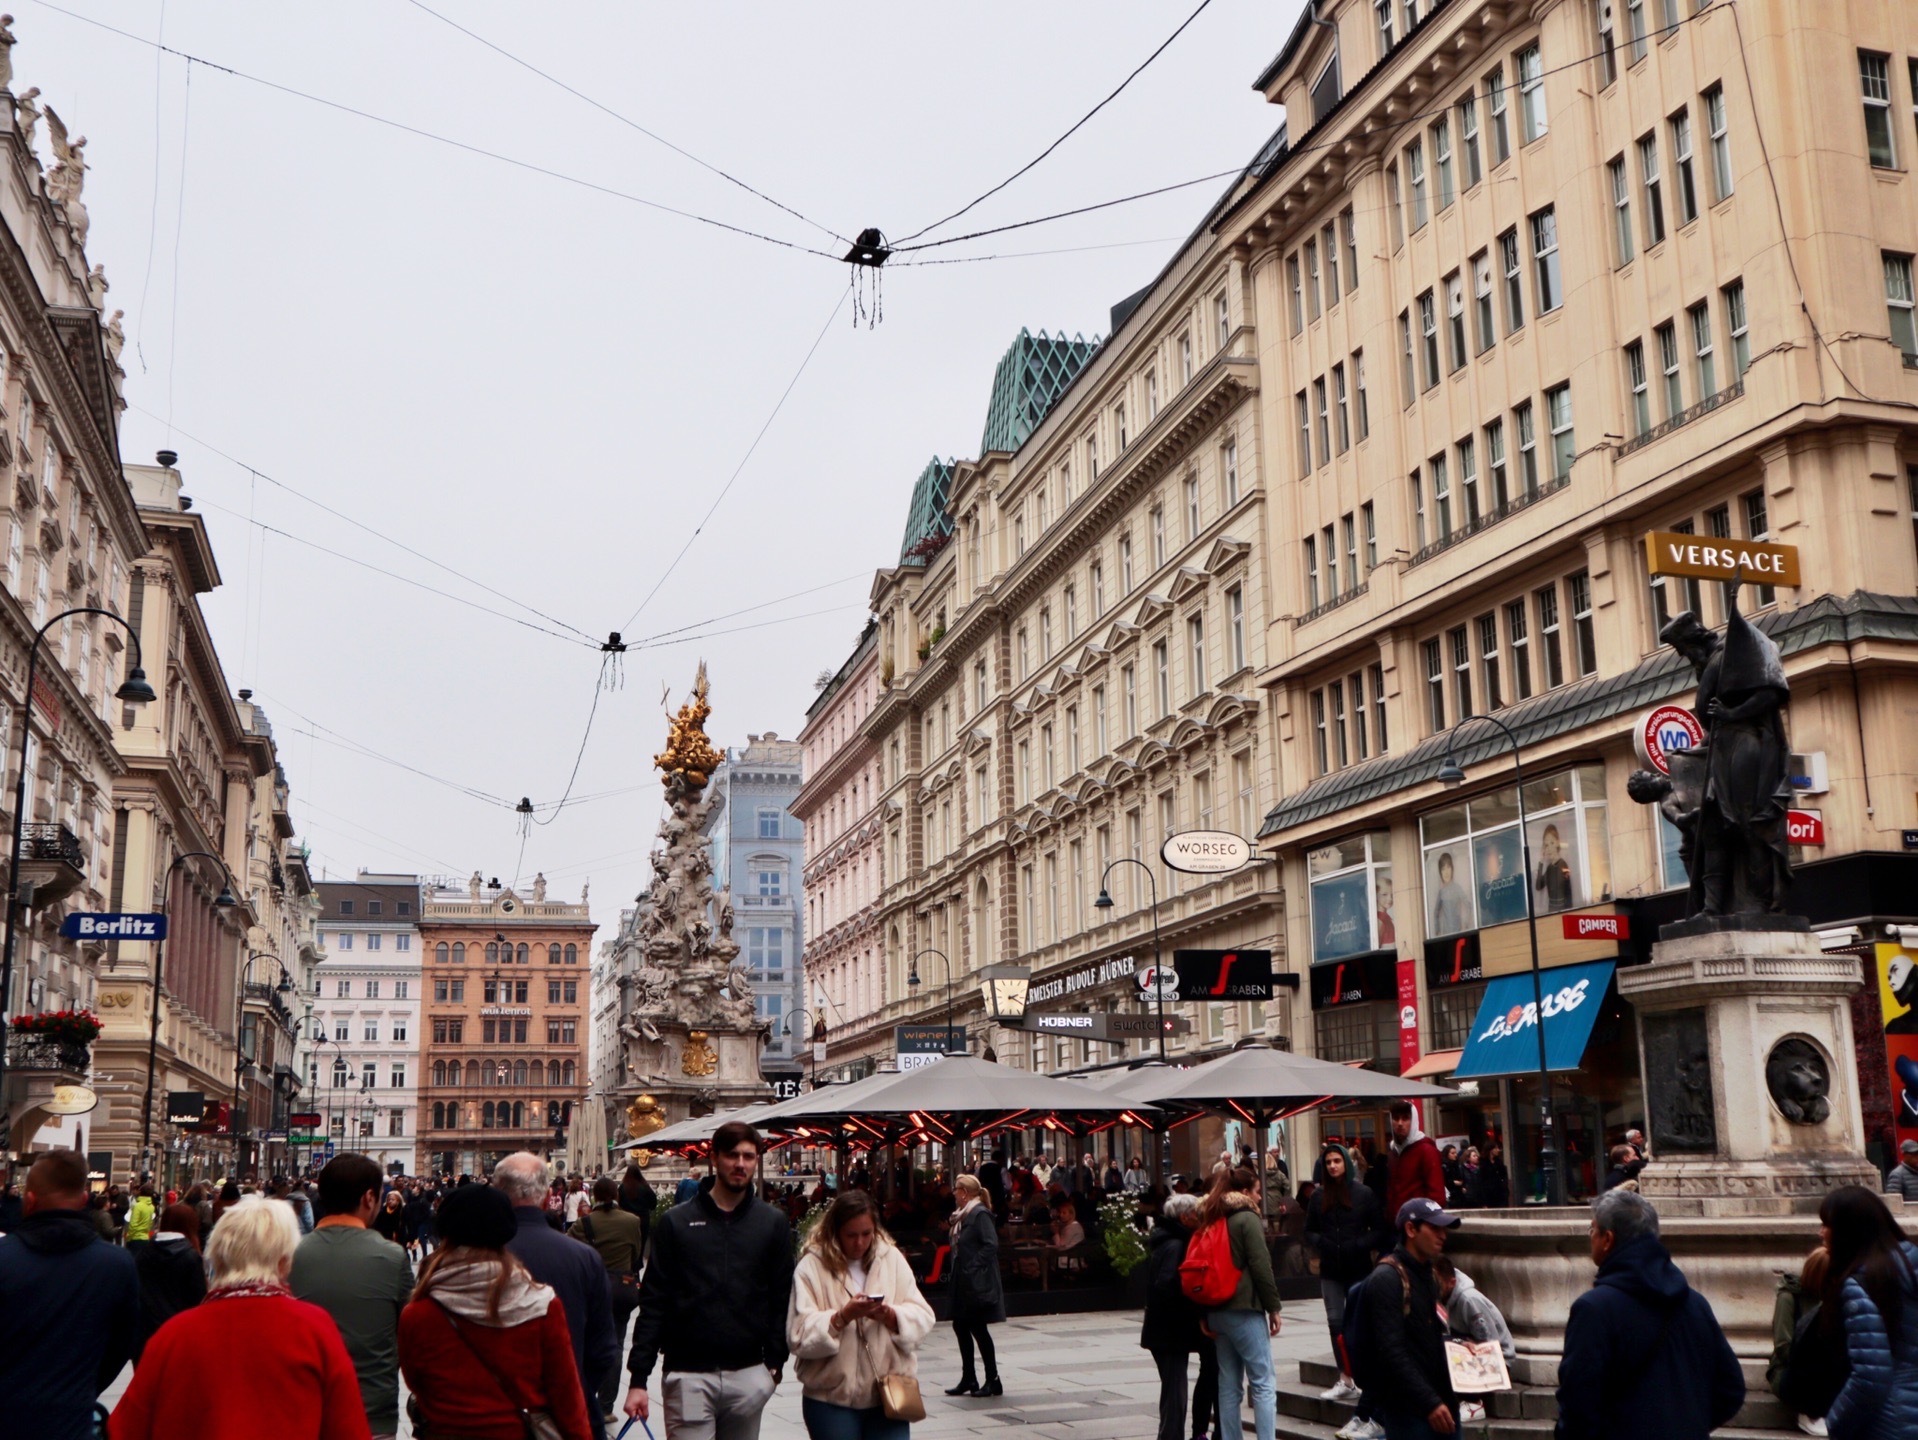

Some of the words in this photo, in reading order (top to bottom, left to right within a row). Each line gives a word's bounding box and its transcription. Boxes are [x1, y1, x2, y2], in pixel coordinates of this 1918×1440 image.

[1669, 544, 1785, 573] VERSACE
[1649, 743, 1660, 756] mit
[1176, 842, 1238, 855] WORSEG
[79, 916, 155, 935] Berlitz
[1325, 915, 1358, 945] jacadi
[1578, 918, 1618, 935] CAMPER
[1065, 968, 1097, 994] RUDOLF
[1097, 956, 1135, 984] HÜBNER
[904, 1031, 960, 1039] wienern
[170, 1115, 199, 1123] MaxMara
